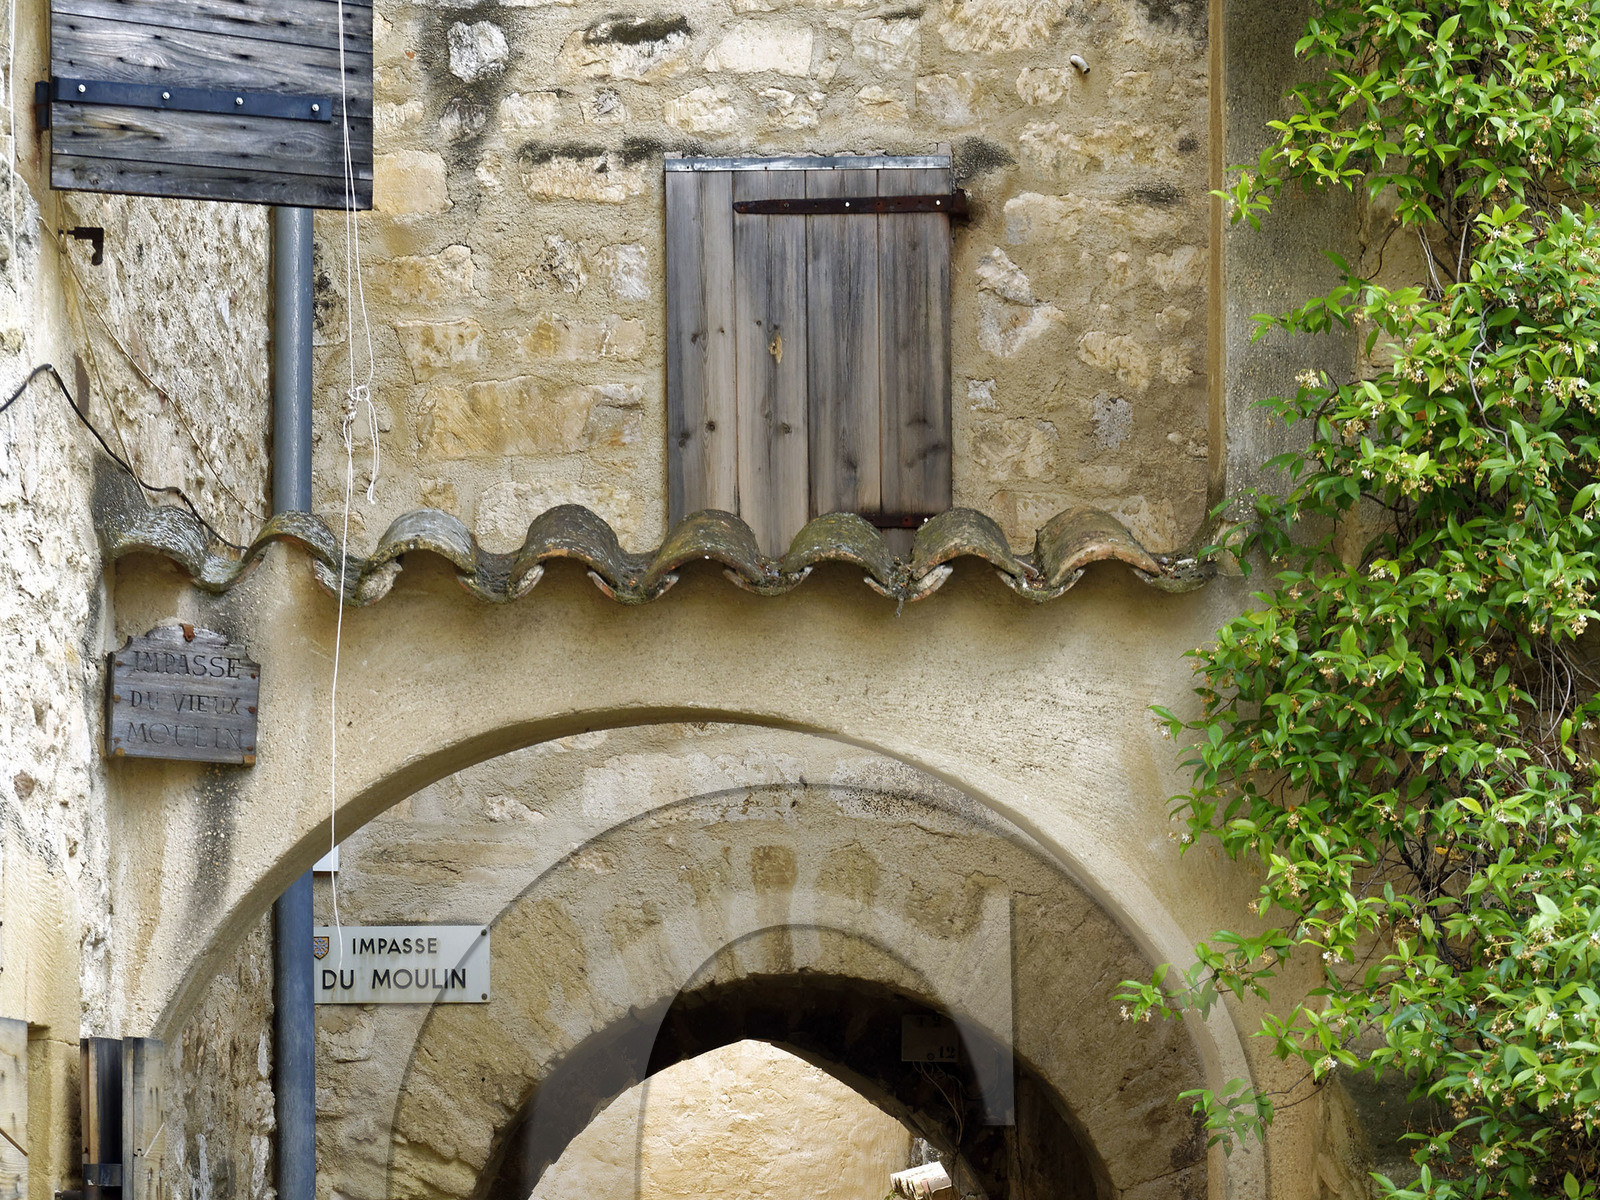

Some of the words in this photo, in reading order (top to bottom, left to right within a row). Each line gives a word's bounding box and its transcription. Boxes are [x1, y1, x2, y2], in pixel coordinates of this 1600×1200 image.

[133, 651, 241, 679] IMPASSE
[130, 690, 160, 711] DU
[172, 693, 241, 715] VIEUX
[127, 721, 243, 750] MOULIN
[352, 937, 438, 955] IMPASSE
[322, 968, 355, 990] DU
[371, 968, 467, 990] MOULIN
